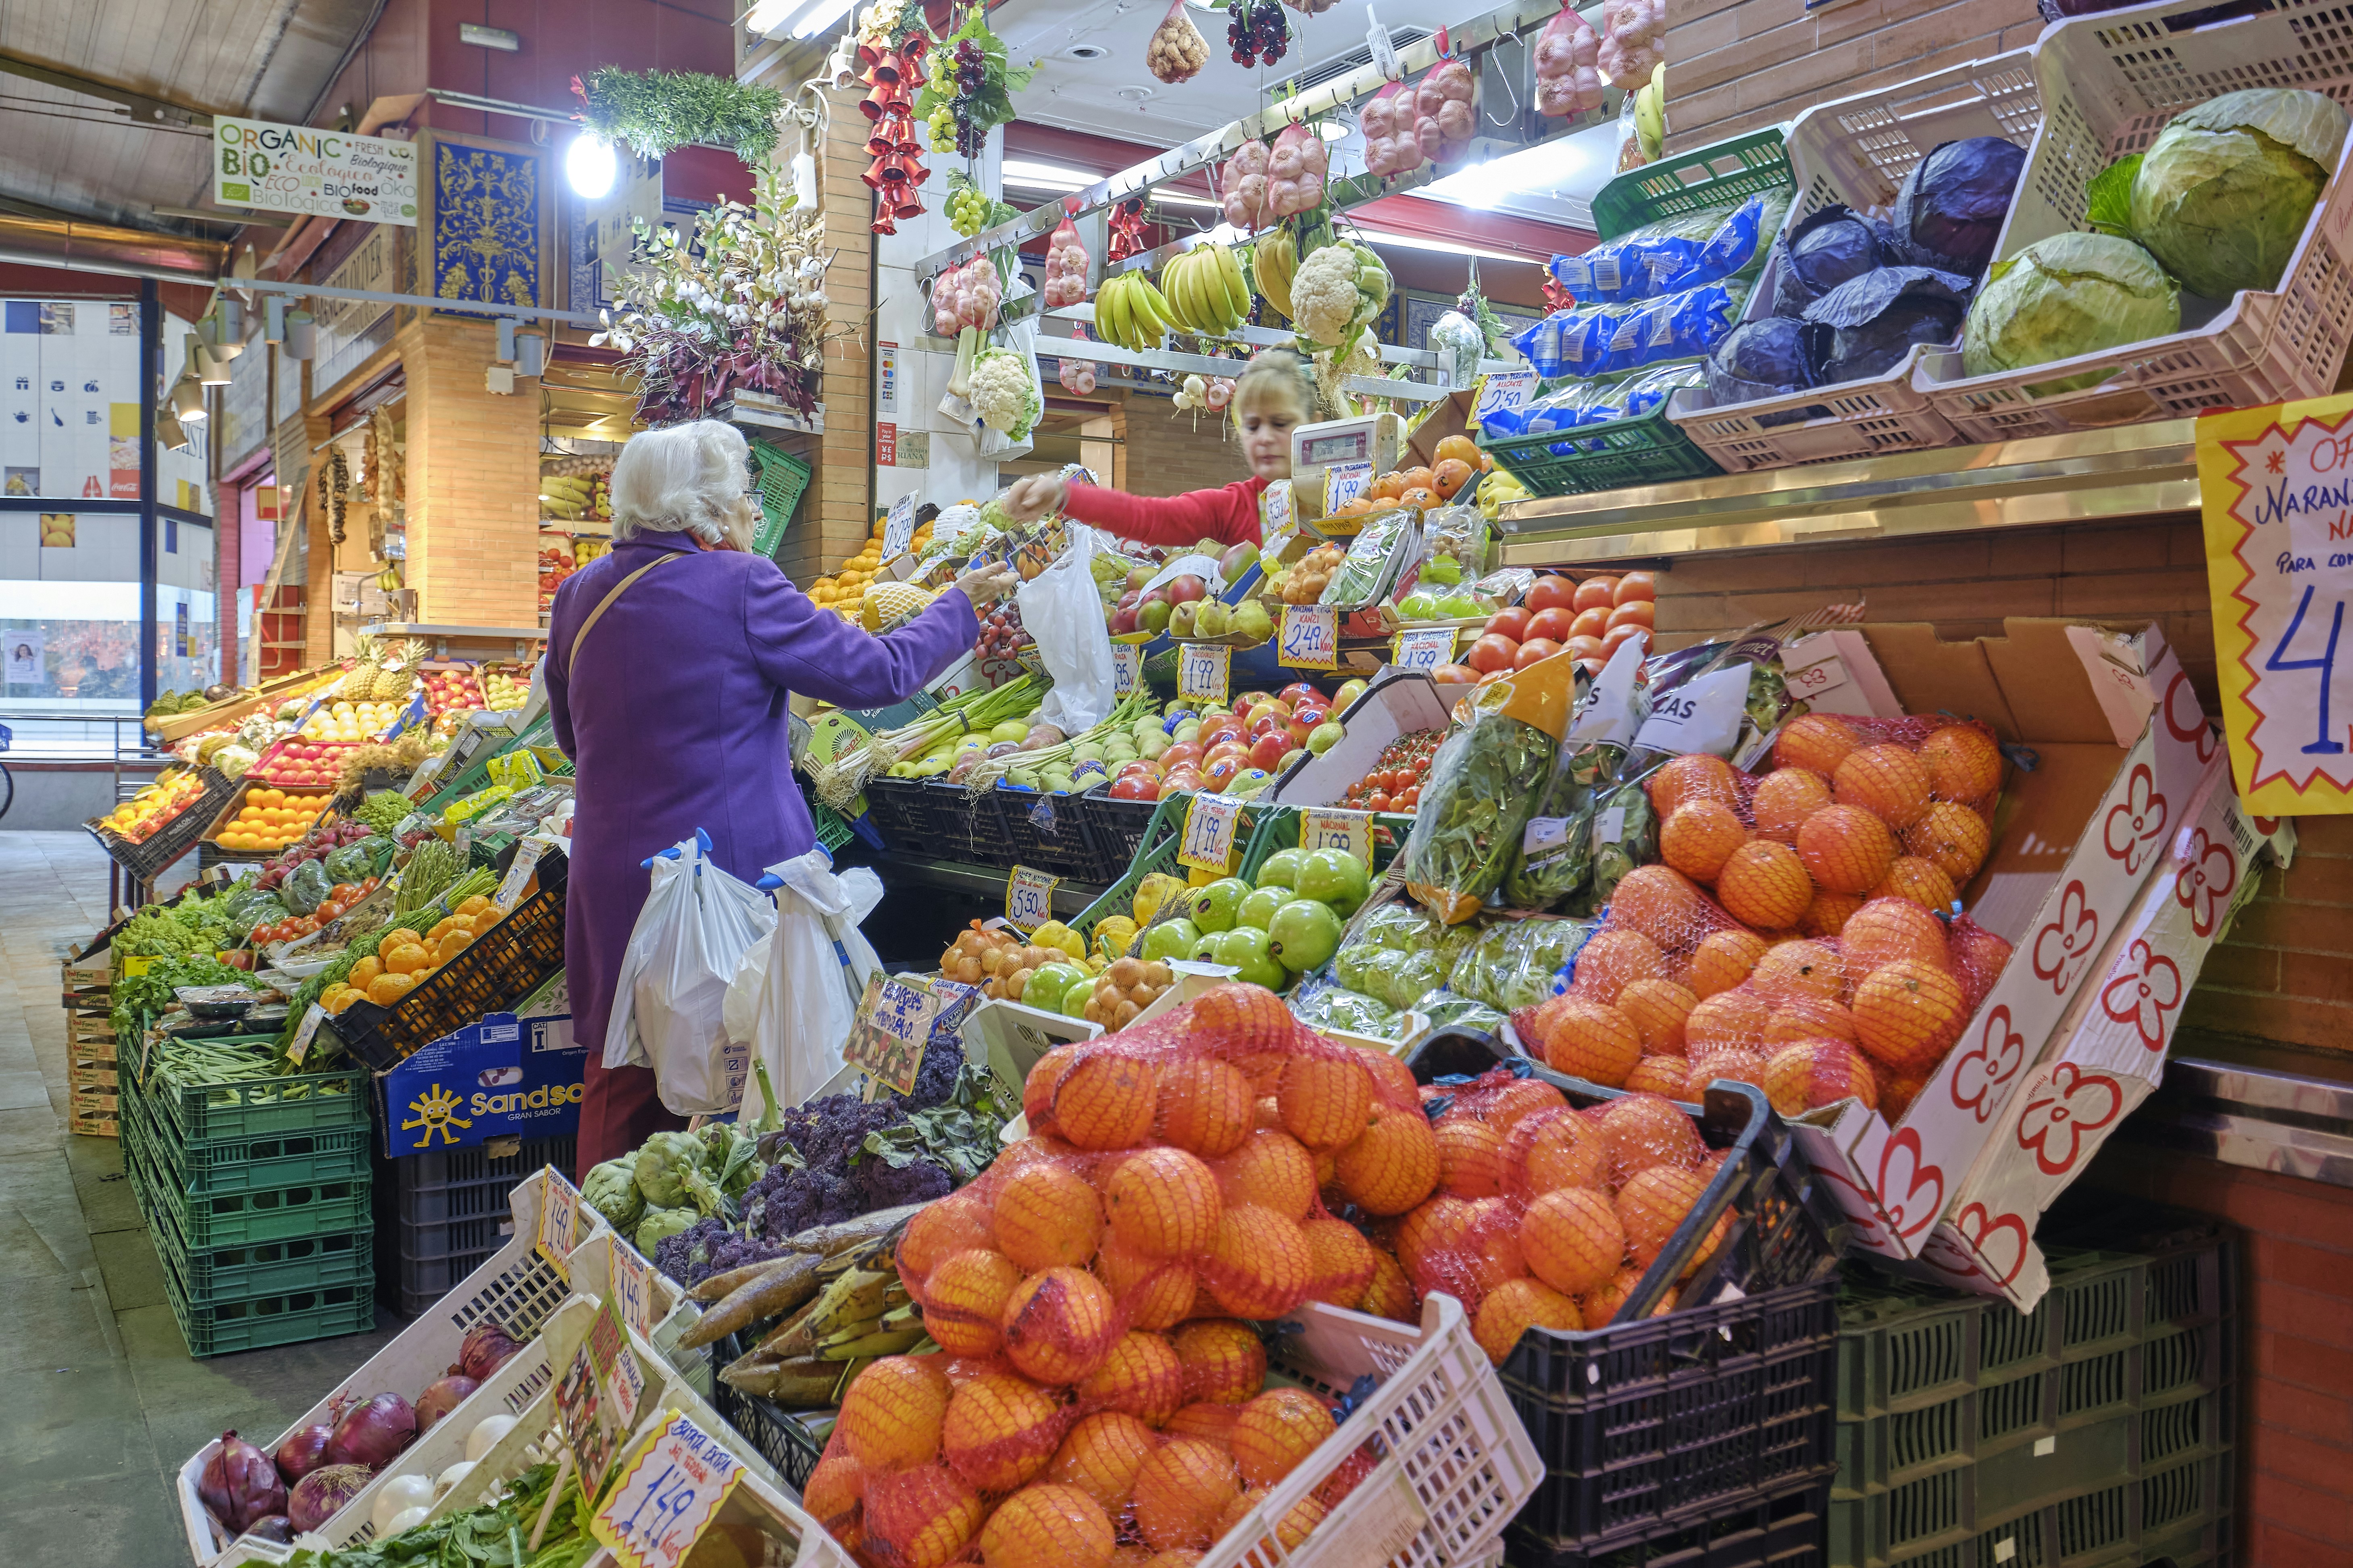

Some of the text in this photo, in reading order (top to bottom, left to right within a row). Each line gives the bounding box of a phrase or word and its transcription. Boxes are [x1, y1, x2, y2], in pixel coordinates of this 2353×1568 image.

[220, 124, 341, 158] ORGANIC
[355, 141, 383, 156] FRESH
[285, 154, 373, 185] Ecológico
[350, 155, 408, 174] Biologique
[264, 175, 300, 192] ECO
[324, 184, 351, 198] BIO
[253, 189, 342, 214] Biológico
[2310, 437, 2353, 473] OF
[111, 483, 137, 492] Coca-Cola
[1339, 472, 1361, 480] NACIONAL
[2255, 476, 2353, 525] NARAN
[1117, 645, 1132, 653] EXTRA
[1285, 624, 1321, 657] 2'49
[1404, 633, 1418, 642] PERA
[1411, 641, 1439, 650] NACIONAL
[1187, 658, 1214, 692] 1'99
[1191, 814, 1220, 855] 1'99
[1320, 820, 1350, 831] NACIONAL
[2140, 838, 2158, 865] Primaflor
[1013, 889, 1038, 919] 5'50
[2070, 956, 2087, 983] Primaflor
[2107, 954, 2126, 980] Primaflor
[955, 984, 968, 993] EXTR
[944, 1000, 966, 1025] LOMAR
[470, 1083, 585, 1116] Sandso
[508, 1108, 561, 1121] GRAN SABOR
[548, 1198, 568, 1250] 1'49
[621, 1268, 640, 1331] 1'49
[619, 1350, 642, 1398] ESPINACAS
[671, 1420, 732, 1477] BATATA EXTRA
[620, 1464, 695, 1548] 1'49
